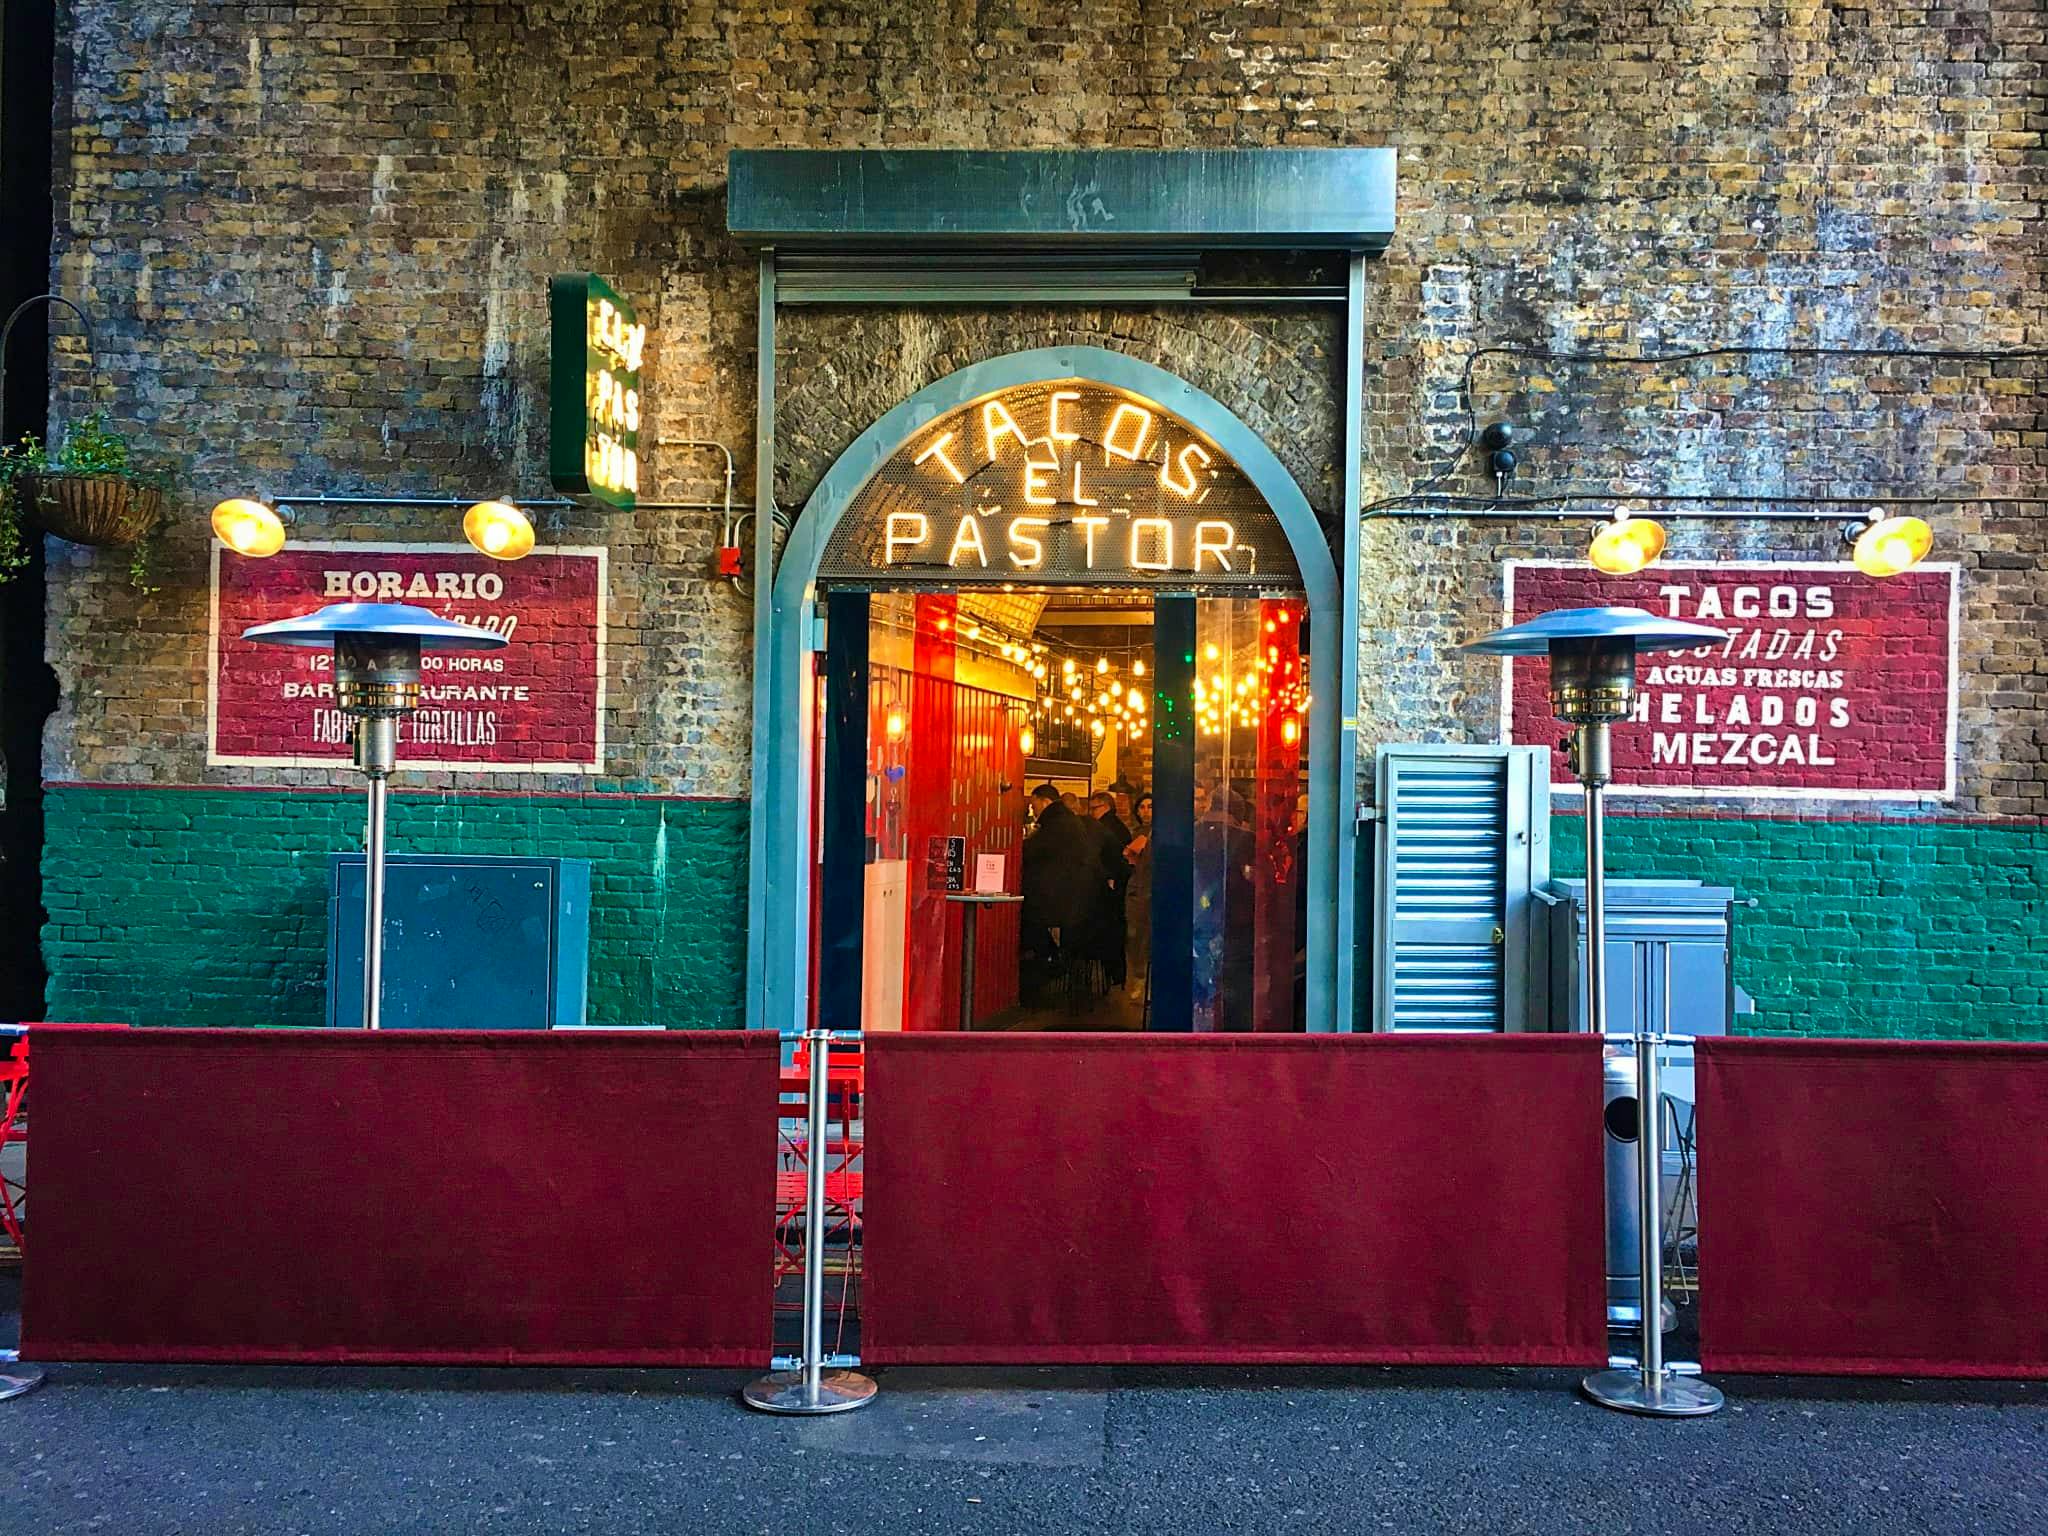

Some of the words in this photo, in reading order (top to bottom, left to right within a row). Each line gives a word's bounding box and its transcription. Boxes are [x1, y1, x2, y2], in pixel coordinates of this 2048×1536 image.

[914, 392, 1210, 496] TACOS
[1023, 461, 1098, 506] EL
[886, 512, 1236, 572] PASTOR
[323, 570, 504, 600] HORARIO
[1659, 585, 1835, 619] TACOS
[1648, 627, 1844, 662] TADAS
[449, 657, 504, 672] HORAS
[1645, 665, 1738, 687] AGUAS
[1743, 668, 1844, 689] FRESCAS
[283, 681, 335, 699] BAR
[413, 710, 496, 745] TORTILLAS
[1627, 692, 1850, 728] HELADOS
[1651, 732, 1836, 767] MEZCAL
